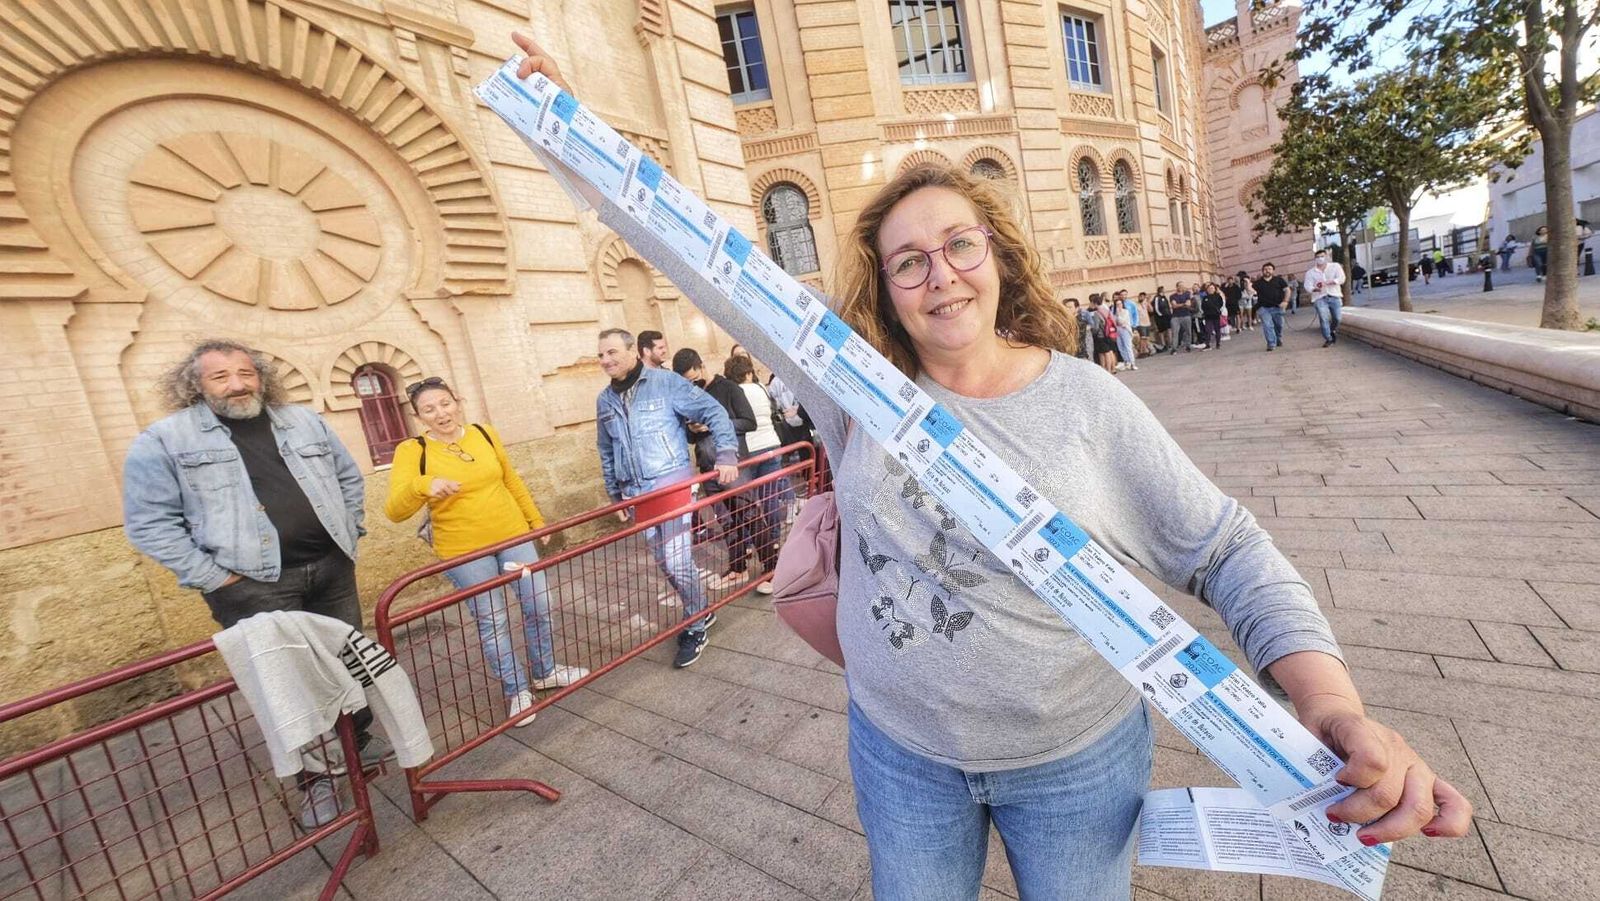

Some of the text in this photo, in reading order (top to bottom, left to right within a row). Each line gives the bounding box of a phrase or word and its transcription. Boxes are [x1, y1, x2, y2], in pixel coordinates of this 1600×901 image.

[1046, 535, 1060, 549] 2022
[1059, 526, 1079, 545] COAC
[1184, 660, 1201, 676] 2022
[1200, 651, 1224, 674] COAC
[1227, 673, 1240, 684] Gran
[1239, 683, 1256, 698] Teatro
[1255, 697, 1267, 709] Falla
[1150, 695, 1170, 717] Unicaja
[1179, 706, 1194, 720] Patio
[1191, 717, 1200, 726] de
[1197, 722, 1216, 741] Butacas
[1253, 736, 1278, 759] ADULTOS
[1277, 757, 1292, 772] COAC
[1303, 837, 1326, 861] Unicaja
[1339, 853, 1354, 868] Patio
